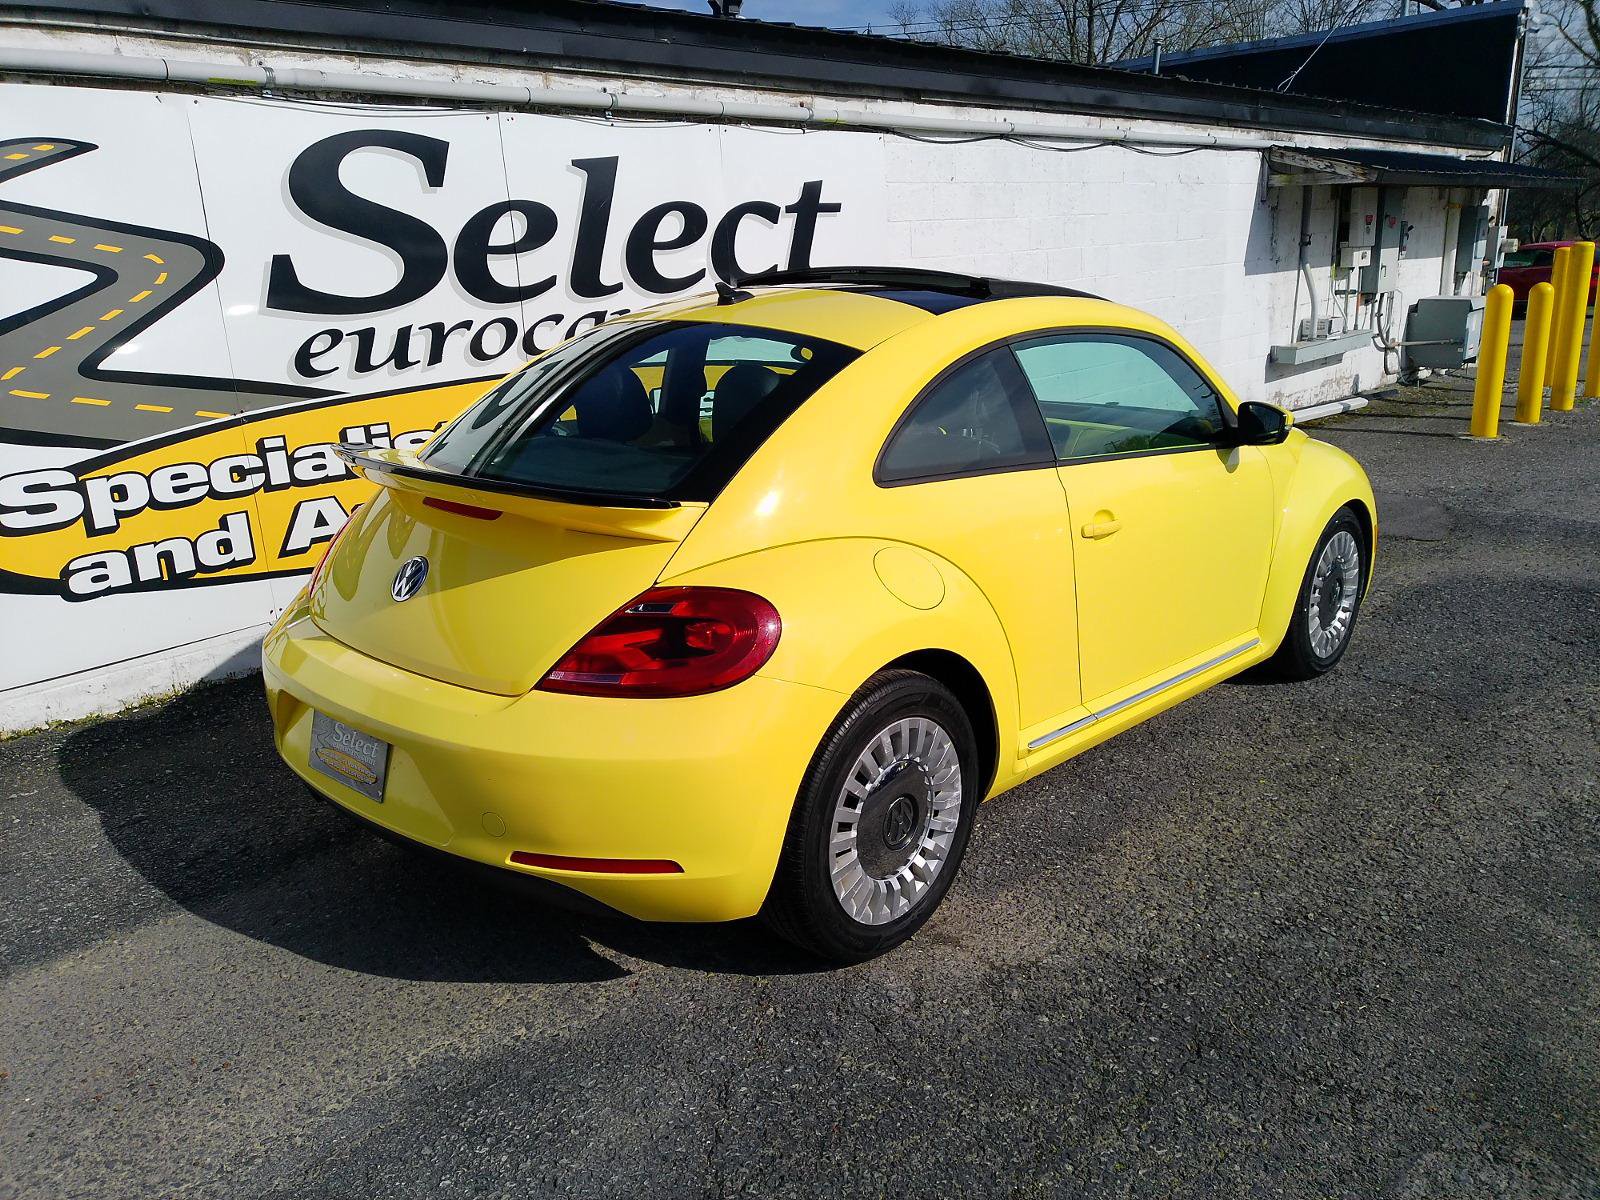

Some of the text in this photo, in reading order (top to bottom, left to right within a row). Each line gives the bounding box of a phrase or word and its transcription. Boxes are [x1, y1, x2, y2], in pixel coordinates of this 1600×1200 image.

[267, 129, 841, 315] Select
[293, 308, 631, 378] euroca
[0, 424, 442, 536] Speciais
[64, 496, 360, 598] and A
[333, 722, 378, 758] Select
